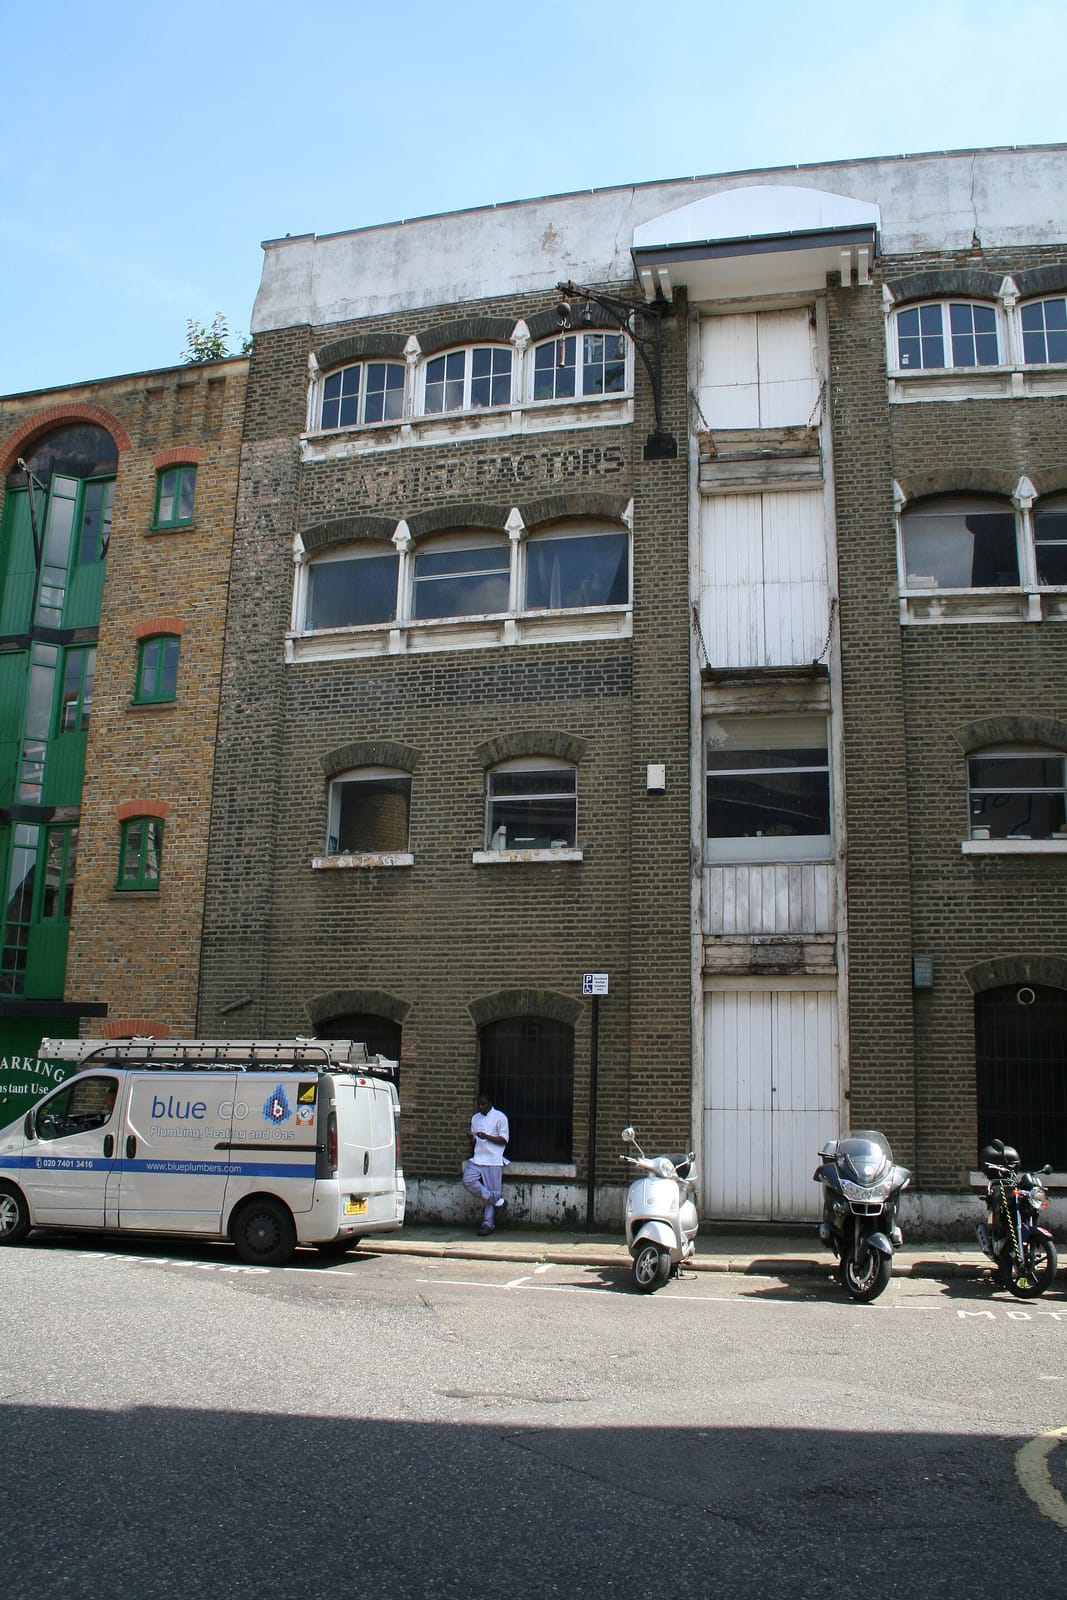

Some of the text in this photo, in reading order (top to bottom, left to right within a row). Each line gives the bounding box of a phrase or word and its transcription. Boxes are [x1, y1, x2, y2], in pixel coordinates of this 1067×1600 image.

[475, 445, 626, 485] FACTORS
[31, 1083, 49, 1094] Use
[152, 1095, 207, 1119] blue
[150, 1126, 202, 1140] Plumbing,
[248, 1128, 270, 1140] and
[272, 1129, 295, 1140] Gas
[43, 1159, 56, 1167] 020
[146, 1161, 242, 1173] www.blueplumbers.com
